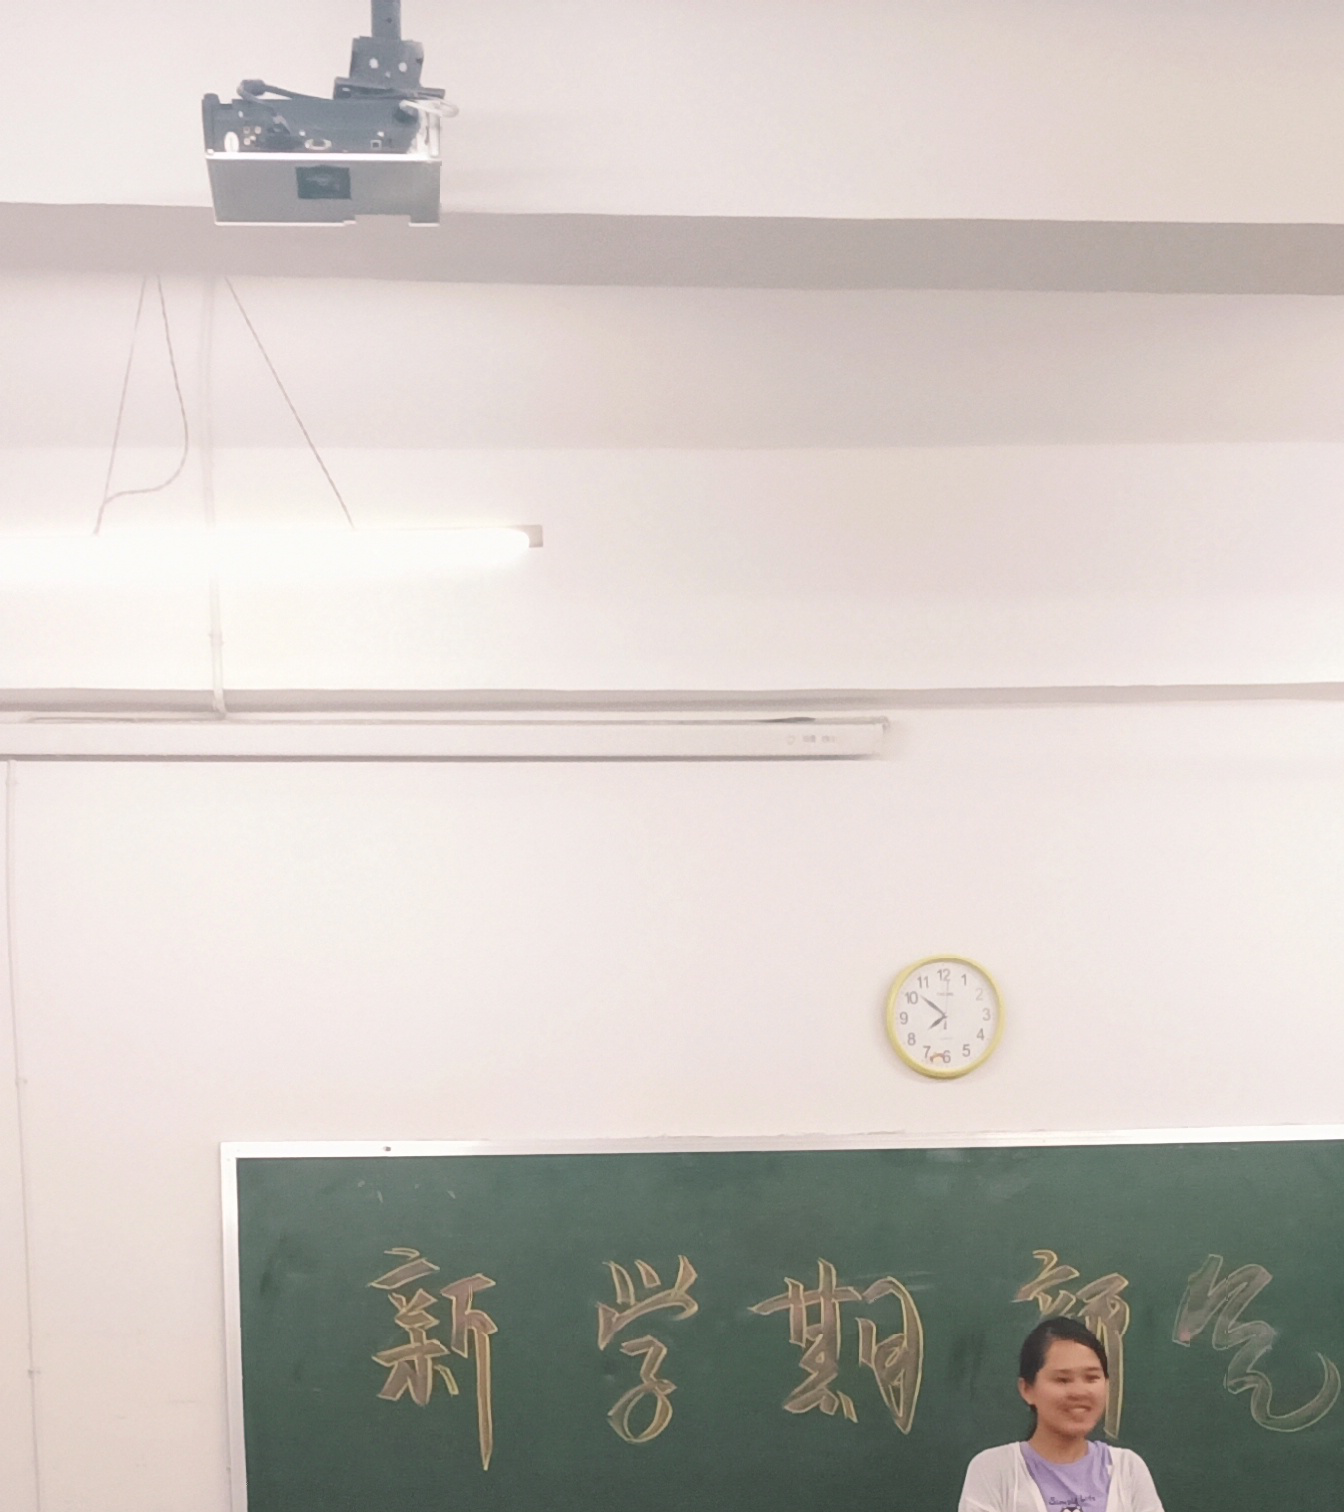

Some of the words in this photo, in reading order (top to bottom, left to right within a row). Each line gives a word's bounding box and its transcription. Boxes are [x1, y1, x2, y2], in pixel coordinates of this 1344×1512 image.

[936, 968, 951, 982] 12
[961, 973, 968, 986] 1
[917, 976, 929, 989] 11
[905, 991, 919, 1005] 10
[975, 987, 984, 1001] 2
[899, 1012, 909, 1025] 9
[982, 1008, 991, 1021] 3
[907, 1032, 916, 1046] 8
[976, 1028, 985, 1041] 4
[923, 1045, 931, 1059] 7
[962, 1044, 971, 1057] 5
